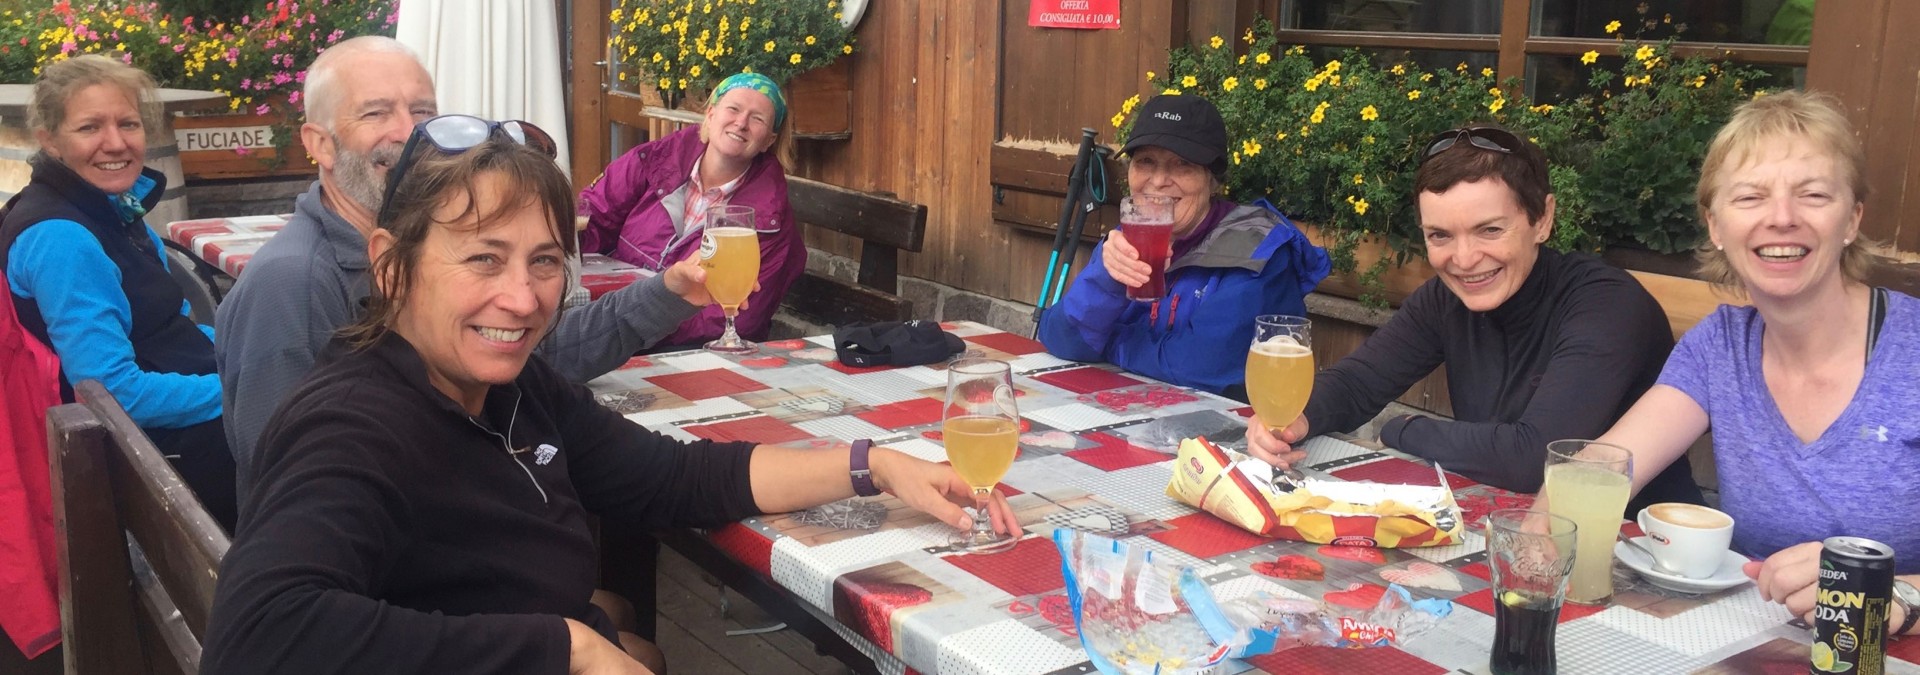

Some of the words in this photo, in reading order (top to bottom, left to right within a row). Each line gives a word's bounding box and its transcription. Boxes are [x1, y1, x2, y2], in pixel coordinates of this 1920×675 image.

[1060, 0, 1089, 10] OFFERTA
[1039, 13, 1084, 23] CONSIGLIATA
[1093, 14, 1114, 24] 10,00
[1161, 111, 1182, 121] Rab
[186, 130, 265, 149] FUCIADE
